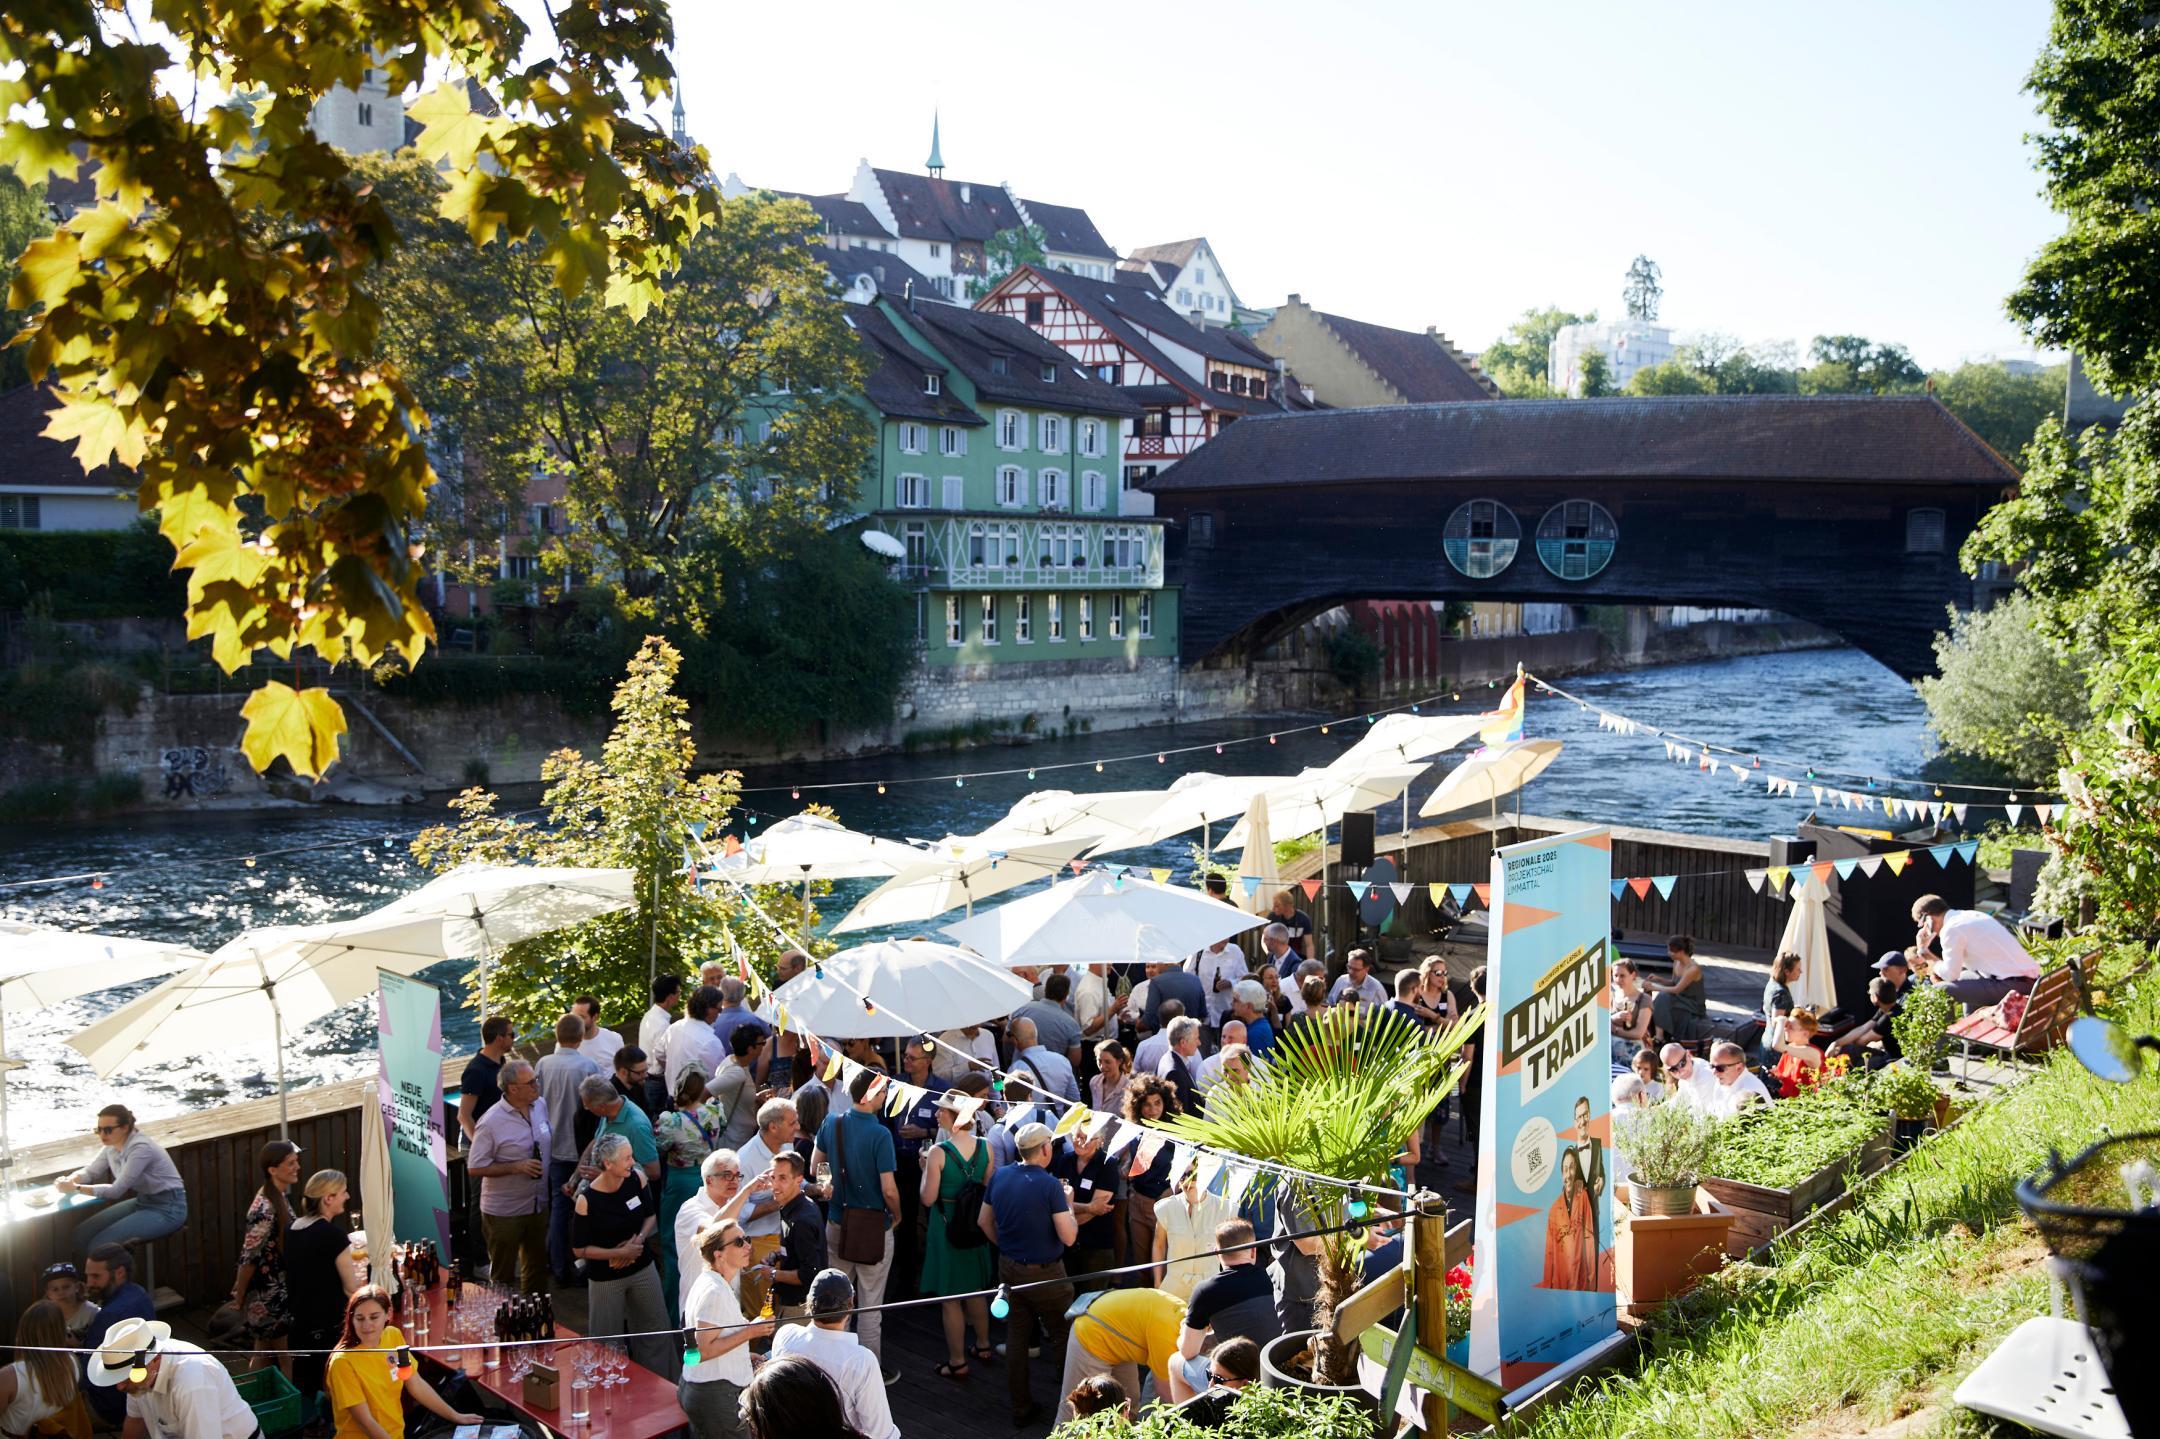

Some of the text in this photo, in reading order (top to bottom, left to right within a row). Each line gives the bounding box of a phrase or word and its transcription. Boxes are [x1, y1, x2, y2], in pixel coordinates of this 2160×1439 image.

[1507, 850, 1558, 871] REGIONALE 2025
[1507, 863, 1554, 882] PROJEKTSCHAU
[1507, 879, 1541, 896] LIMMATTAL
[1511, 948, 1602, 1053] LIMMAT
[1527, 1011, 1594, 1089] TRAIL
[400, 1080, 422, 1098] NEUE
[391, 1092, 432, 1117] IDEEN FÜR
[391, 1121, 433, 1146] RAUM UND
[397, 1137, 429, 1159] KULTUR
